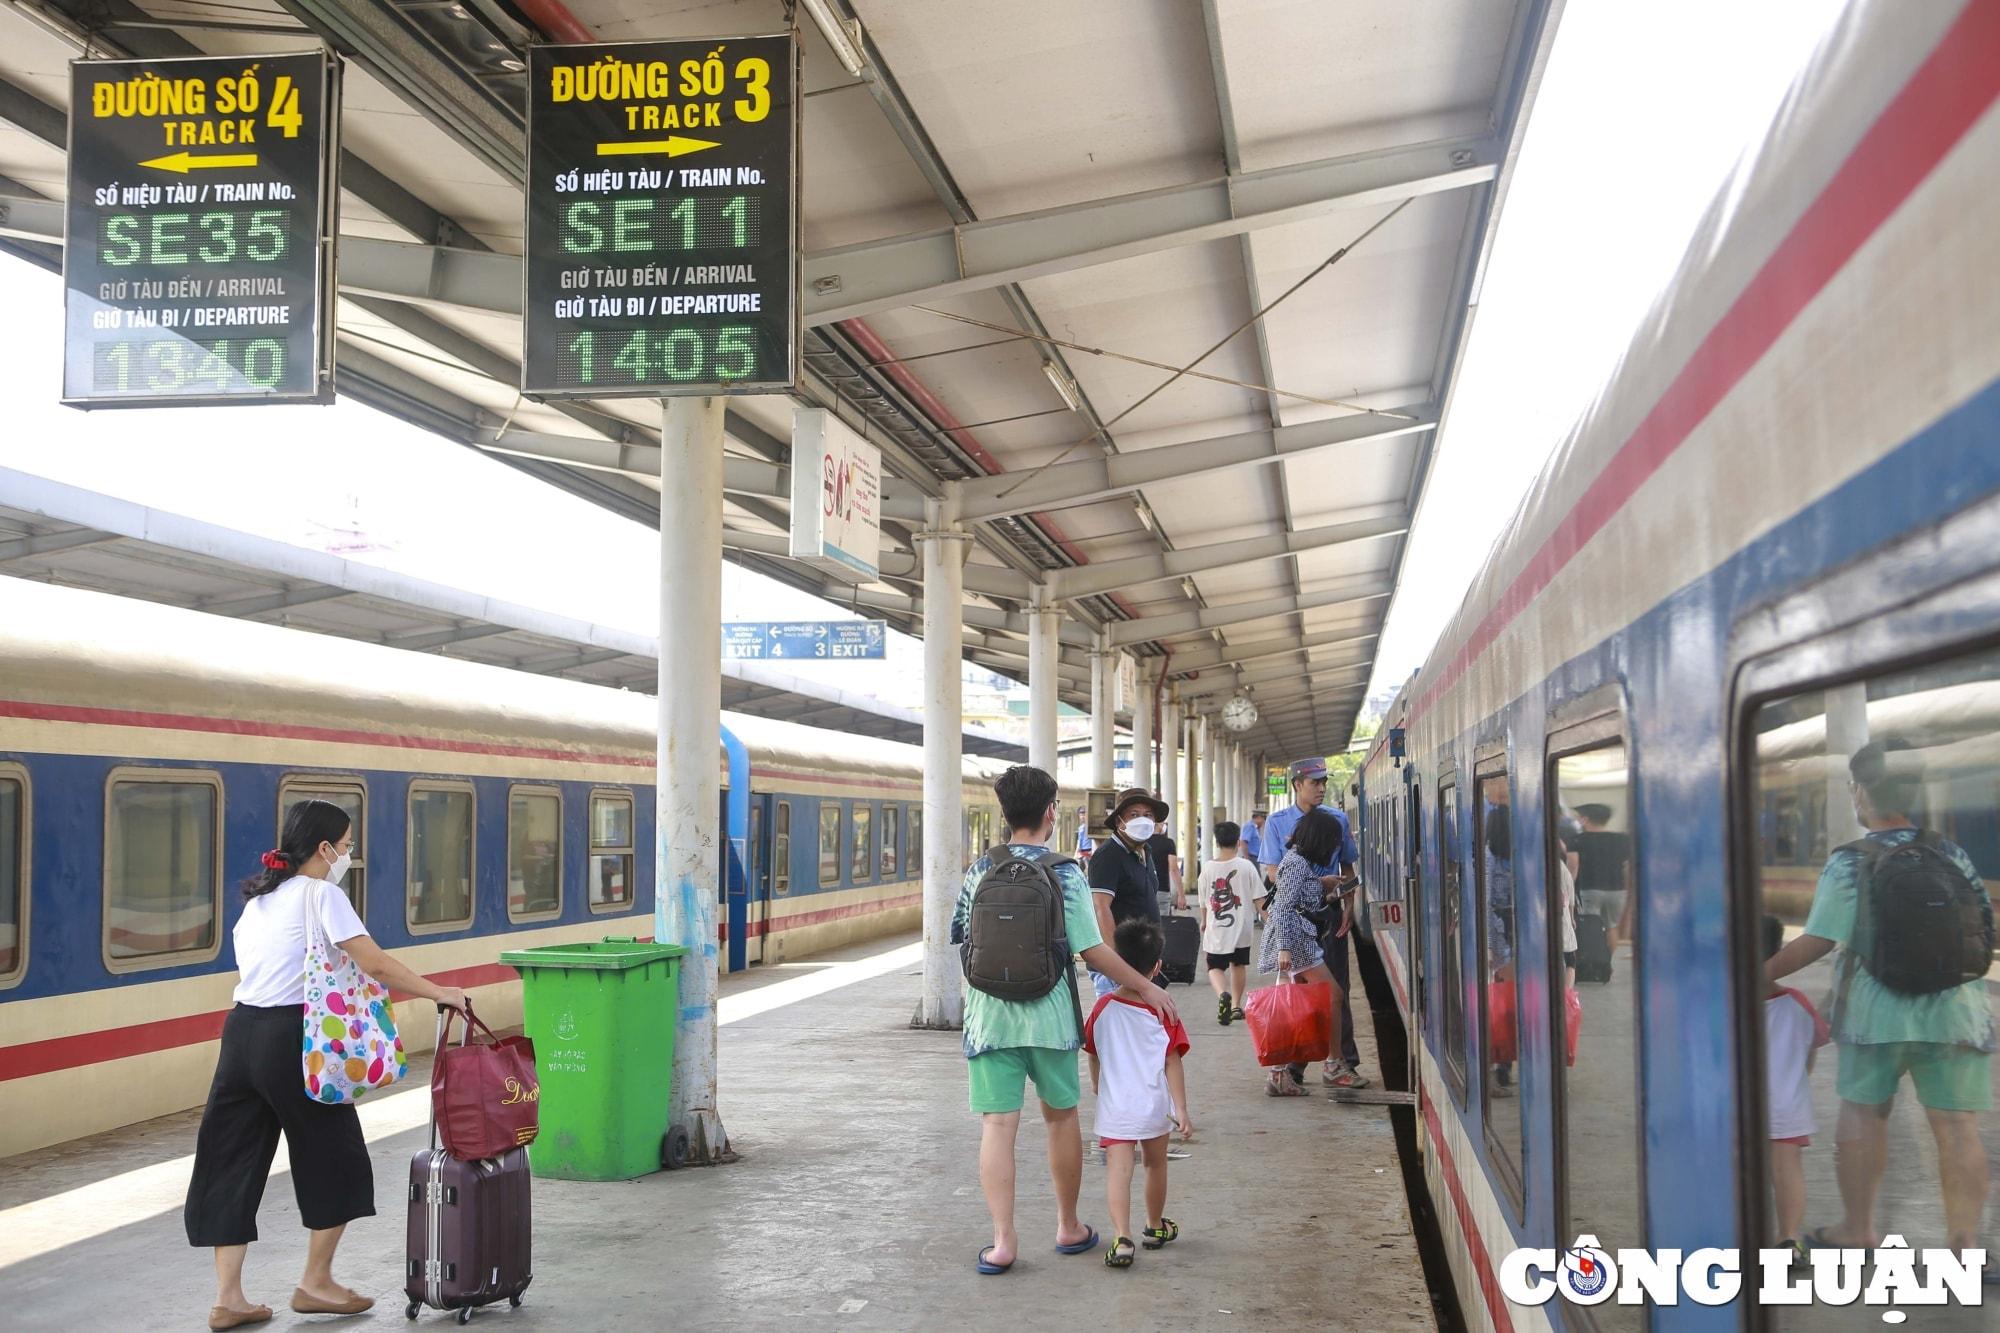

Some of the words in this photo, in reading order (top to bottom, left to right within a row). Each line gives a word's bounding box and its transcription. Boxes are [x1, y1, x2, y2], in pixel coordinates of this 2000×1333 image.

[551, 56, 668, 102] ĐƯỜNG
[679, 46, 726, 96] SỐ
[735, 57, 771, 122] 3
[93, 71, 206, 117] ĐƯỜNG
[215, 63, 260, 113] SỐ
[267, 76, 302, 138] 4
[625, 103, 721, 130] TRACK
[163, 119, 255, 146] TRACK
[555, 167, 579, 192] SỐ
[583, 169, 623, 194] HIỆU
[628, 168, 661, 189] TÀU
[679, 168, 731, 187] TRAIN
[737, 167, 765, 185] No.
[122, 183, 161, 208] HIỆU
[165, 182, 197, 204] TÀU
[214, 183, 264, 202] TRAIN
[268, 182, 296, 200] No.
[103, 210, 284, 265] SE35
[560, 266, 589, 289] GIỜ
[595, 265, 627, 288] TÀU
[632, 262, 667, 286] ĐẾN
[684, 265, 756, 285] ARRIVAL
[100, 280, 127, 300] GIỜ
[132, 278, 162, 299] TÀU
[217, 278, 285, 297] ARRIVAL
[93, 308, 121, 329] GIỜ
[126, 306, 156, 328] TÀU
[162, 309, 178, 327] ĐI
[194, 306, 289, 326] DEPARTURE
[555, 295, 584, 318] GIỜ
[589, 294, 621, 317] TÀU
[627, 297, 645, 316] ĐI
[661, 293, 761, 315] DEPARTURE
[106, 339, 282, 393] 13:40
[570, 327, 754, 382] 14:05
[725, 644, 762, 657] EXIT
[771, 642, 783, 657] 4
[815, 642, 826, 657] 3
[832, 644, 868, 657] EXIT
[1381, 904, 1401, 923] 10
